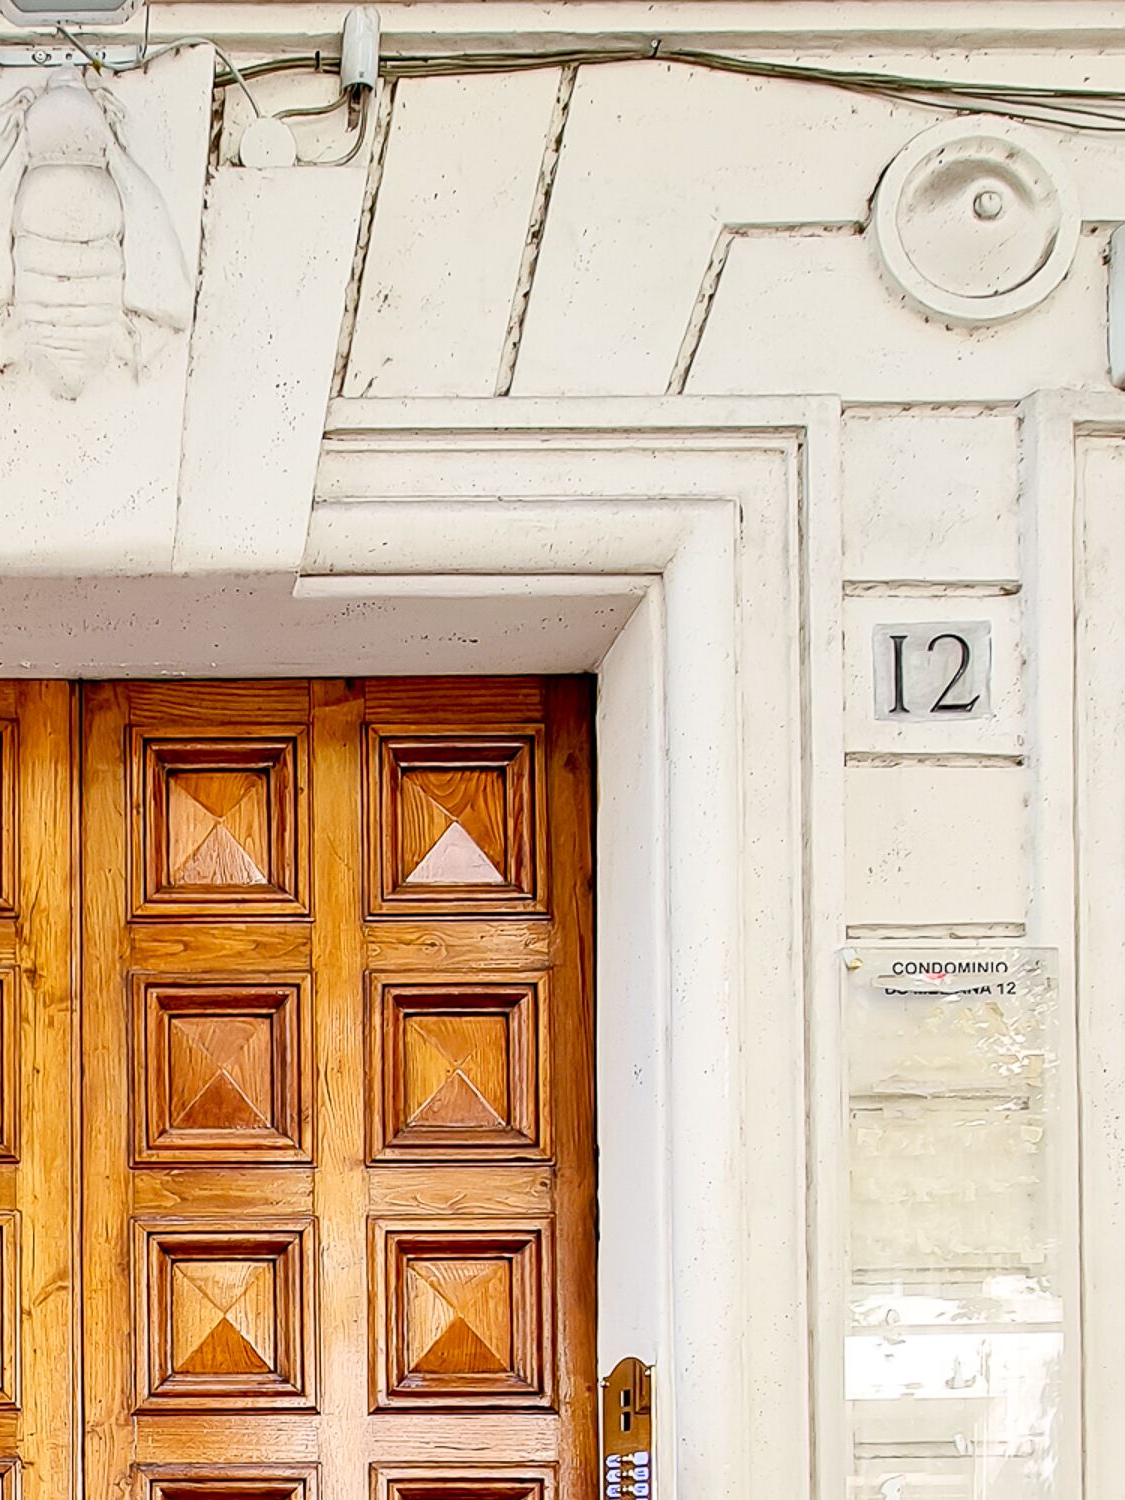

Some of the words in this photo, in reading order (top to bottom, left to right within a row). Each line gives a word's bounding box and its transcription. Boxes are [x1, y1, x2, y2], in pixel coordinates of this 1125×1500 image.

[888, 634, 981, 713] 12
[892, 962, 1008, 975] CONDOMINIO
[997, 982, 1016, 995] 12
